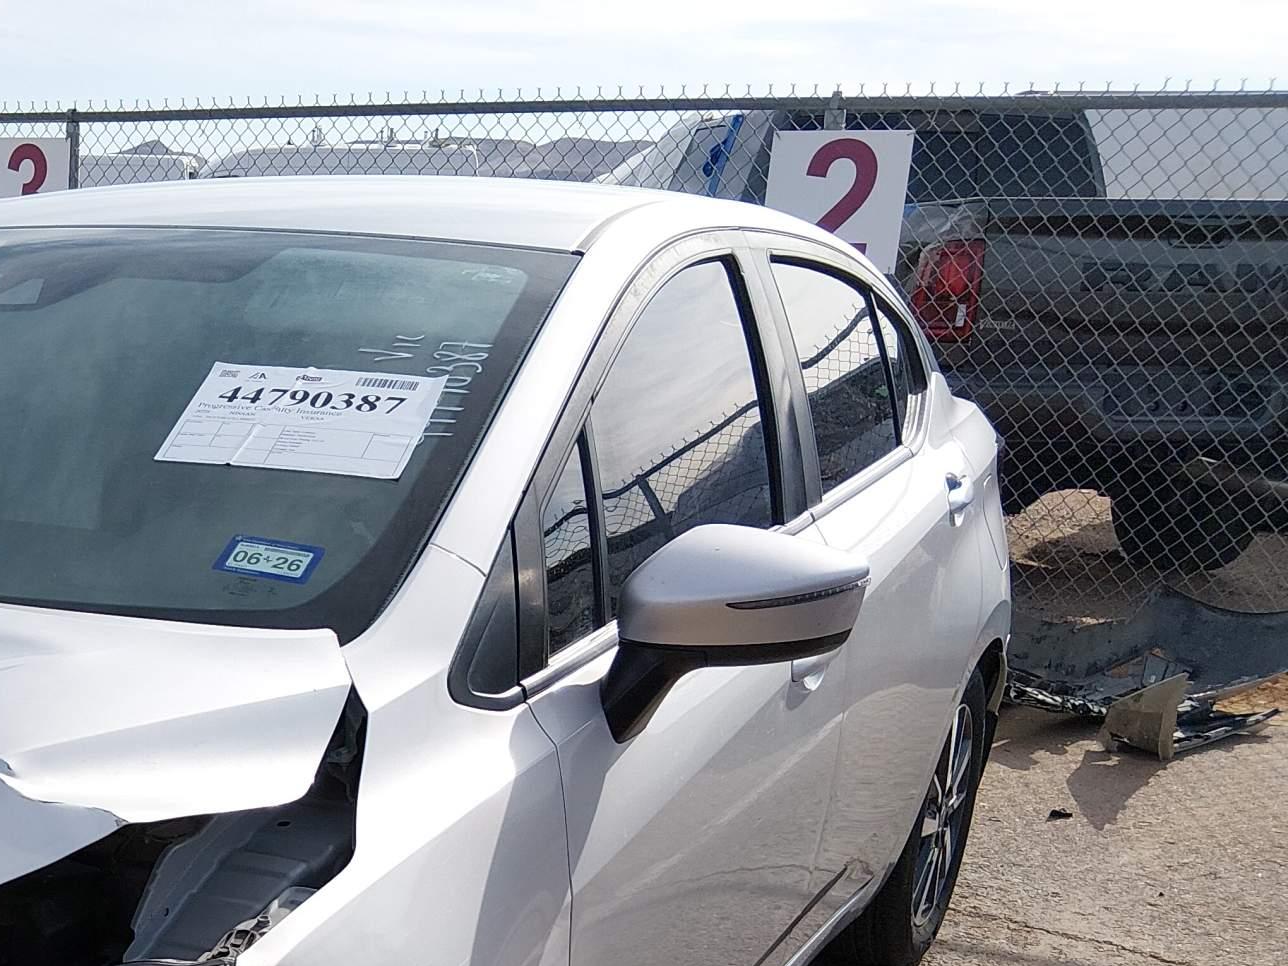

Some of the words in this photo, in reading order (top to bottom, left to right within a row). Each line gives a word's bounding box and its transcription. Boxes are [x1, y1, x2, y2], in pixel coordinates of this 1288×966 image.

[806, 137, 878, 256] 2
[218, 386, 408, 415] 44790387
[232, 550, 263, 565] 06
[271, 556, 304, 572] 26
